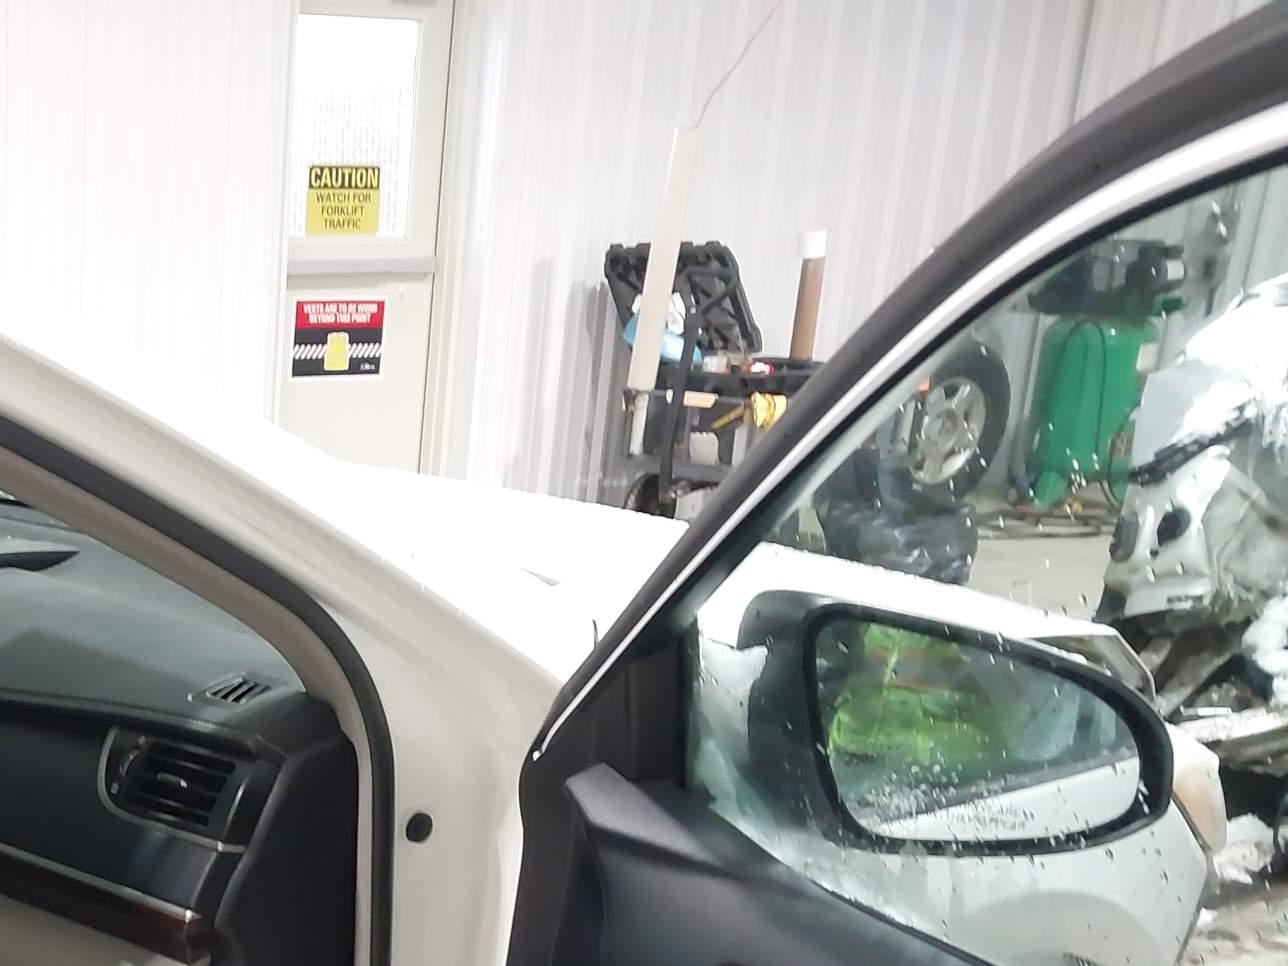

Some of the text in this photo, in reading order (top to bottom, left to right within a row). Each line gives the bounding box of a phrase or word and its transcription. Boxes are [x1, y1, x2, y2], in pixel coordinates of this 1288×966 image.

[311, 167, 379, 188] CAUTION
[316, 192, 372, 203] WATCH FOR
[321, 205, 364, 217] FORKLIFT
[324, 218, 362, 230] TRAFFIC
